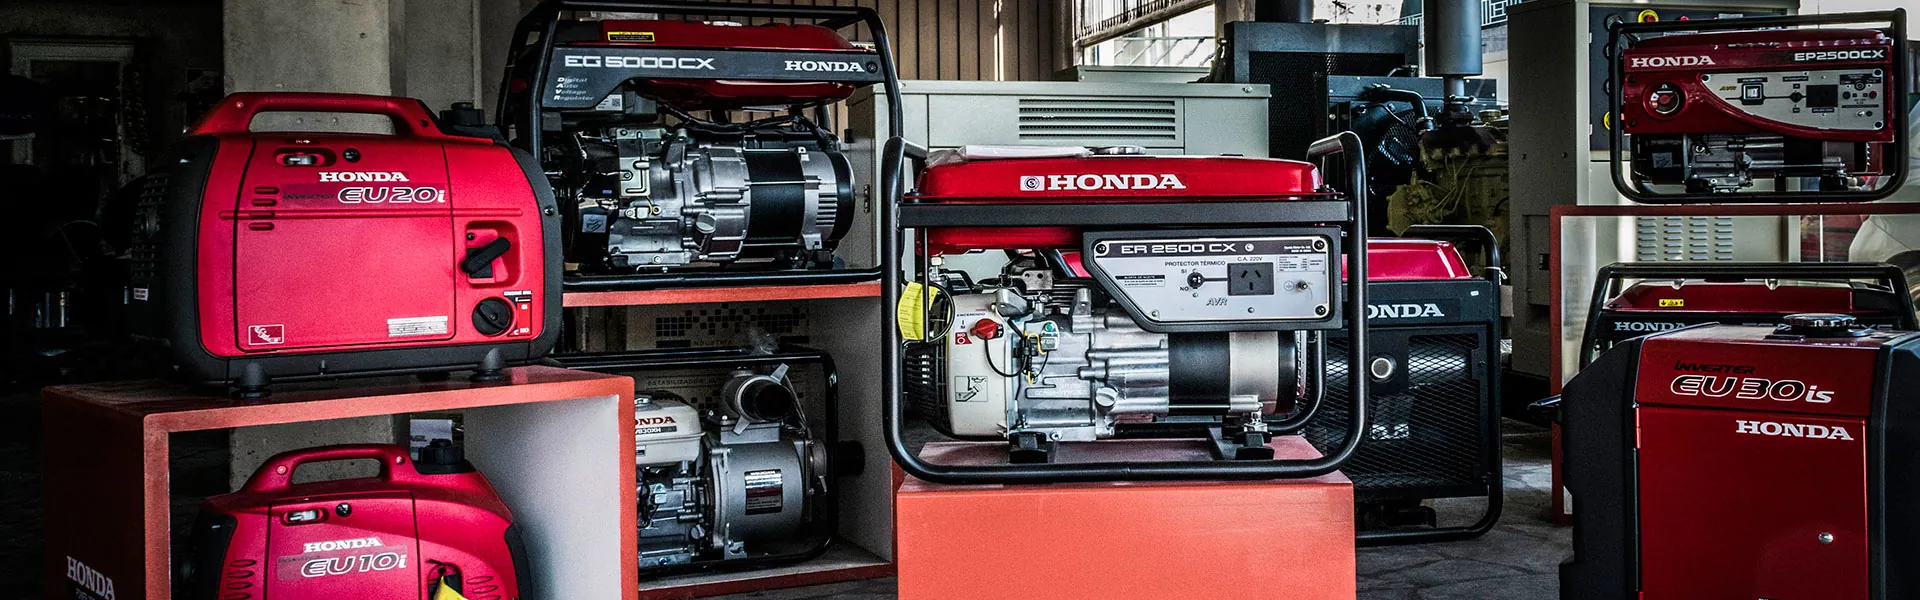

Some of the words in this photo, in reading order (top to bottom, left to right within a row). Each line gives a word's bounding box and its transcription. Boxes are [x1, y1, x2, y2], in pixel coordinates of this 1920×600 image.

[564, 55, 601, 67] EG
[1631, 55, 1716, 67] HONDA
[1794, 50, 1884, 61] EP2500CX
[784, 60, 866, 72] HONDA
[319, 172, 410, 182] HONDA
[1047, 174, 1187, 190] HONDA
[1121, 245, 1148, 254] ER
[1152, 244, 1205, 253] 2500
[1209, 243, 1237, 253] CX
[1206, 298, 1228, 306] AVR
[1367, 303, 1445, 319] ONDA
[634, 415, 677, 426] NDA
[1736, 419, 1855, 441] HONDA
[303, 537, 383, 552] HONDA
[66, 555, 116, 600] HONDA
